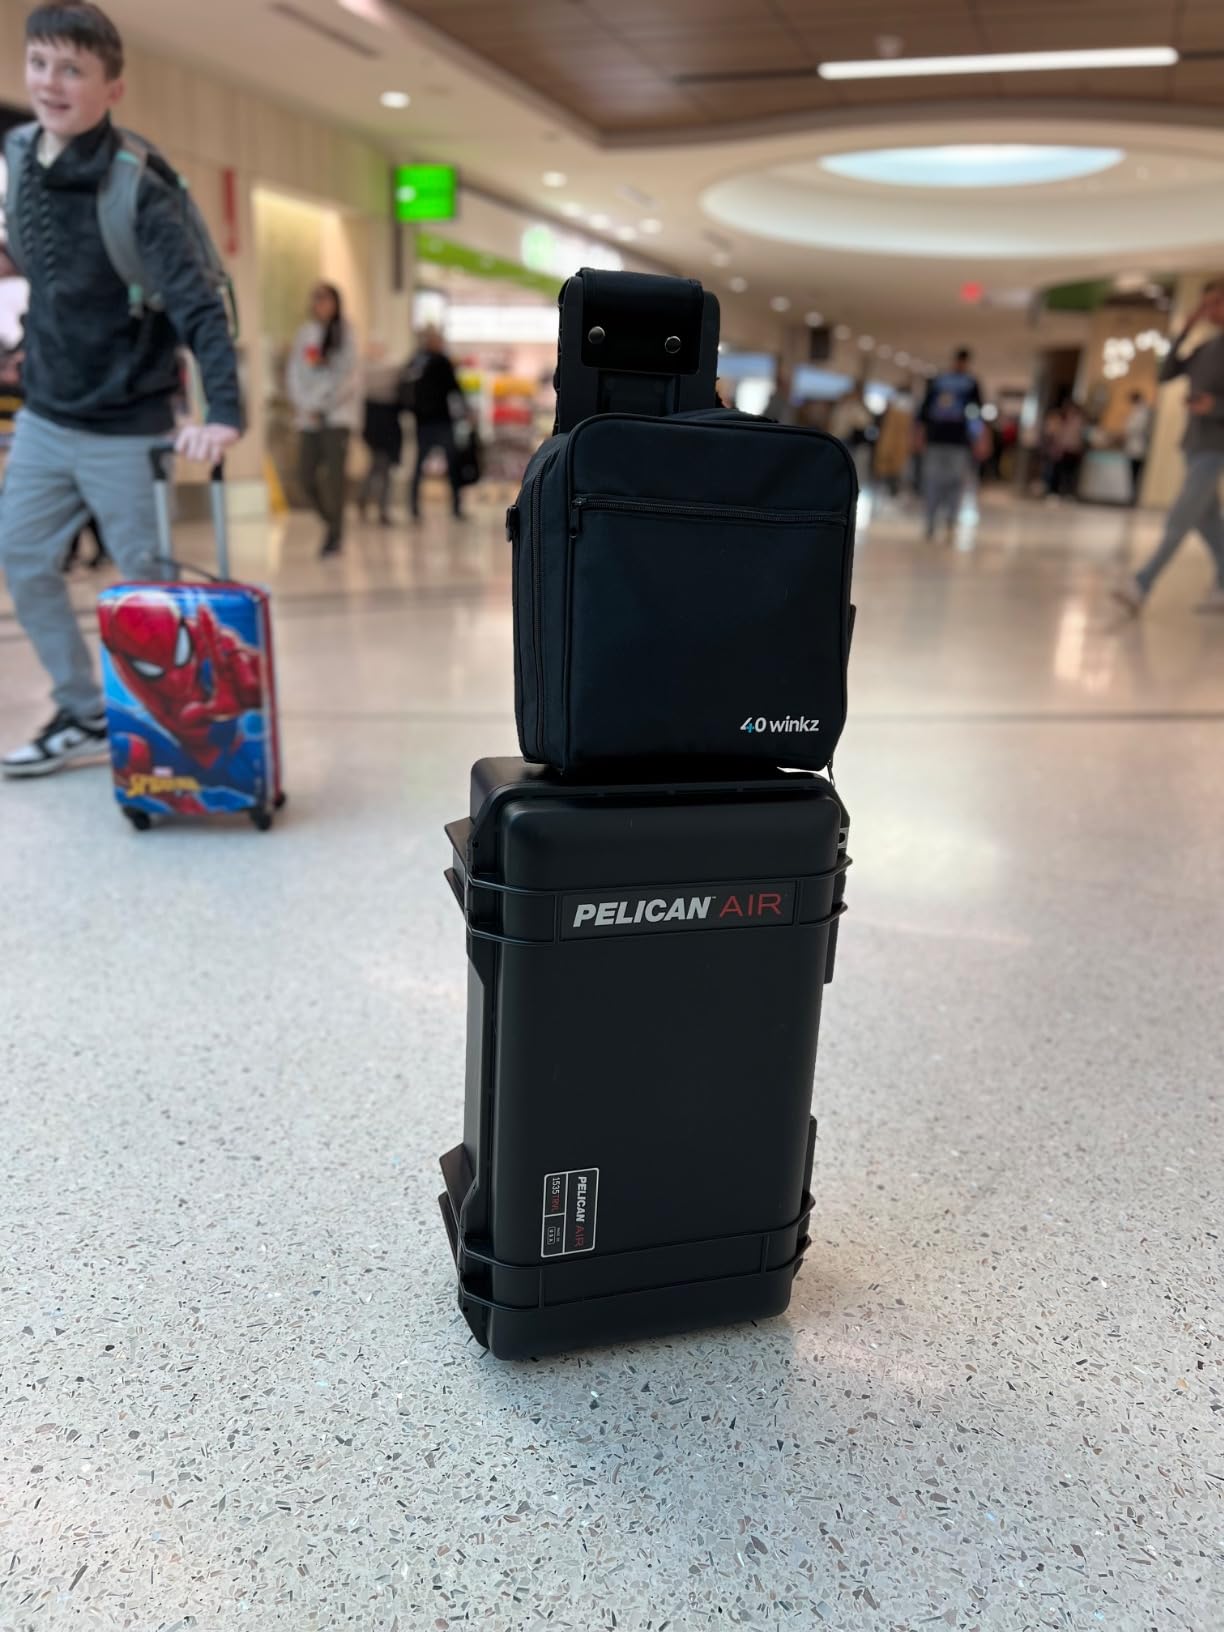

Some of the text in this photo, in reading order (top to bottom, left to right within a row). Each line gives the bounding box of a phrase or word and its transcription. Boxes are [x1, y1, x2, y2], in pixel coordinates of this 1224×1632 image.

[740, 715, 820, 733] 40 winkz
[573, 893, 783, 928] PELICAN AIR
[575, 1176, 587, 1247] PELICAN AIR
